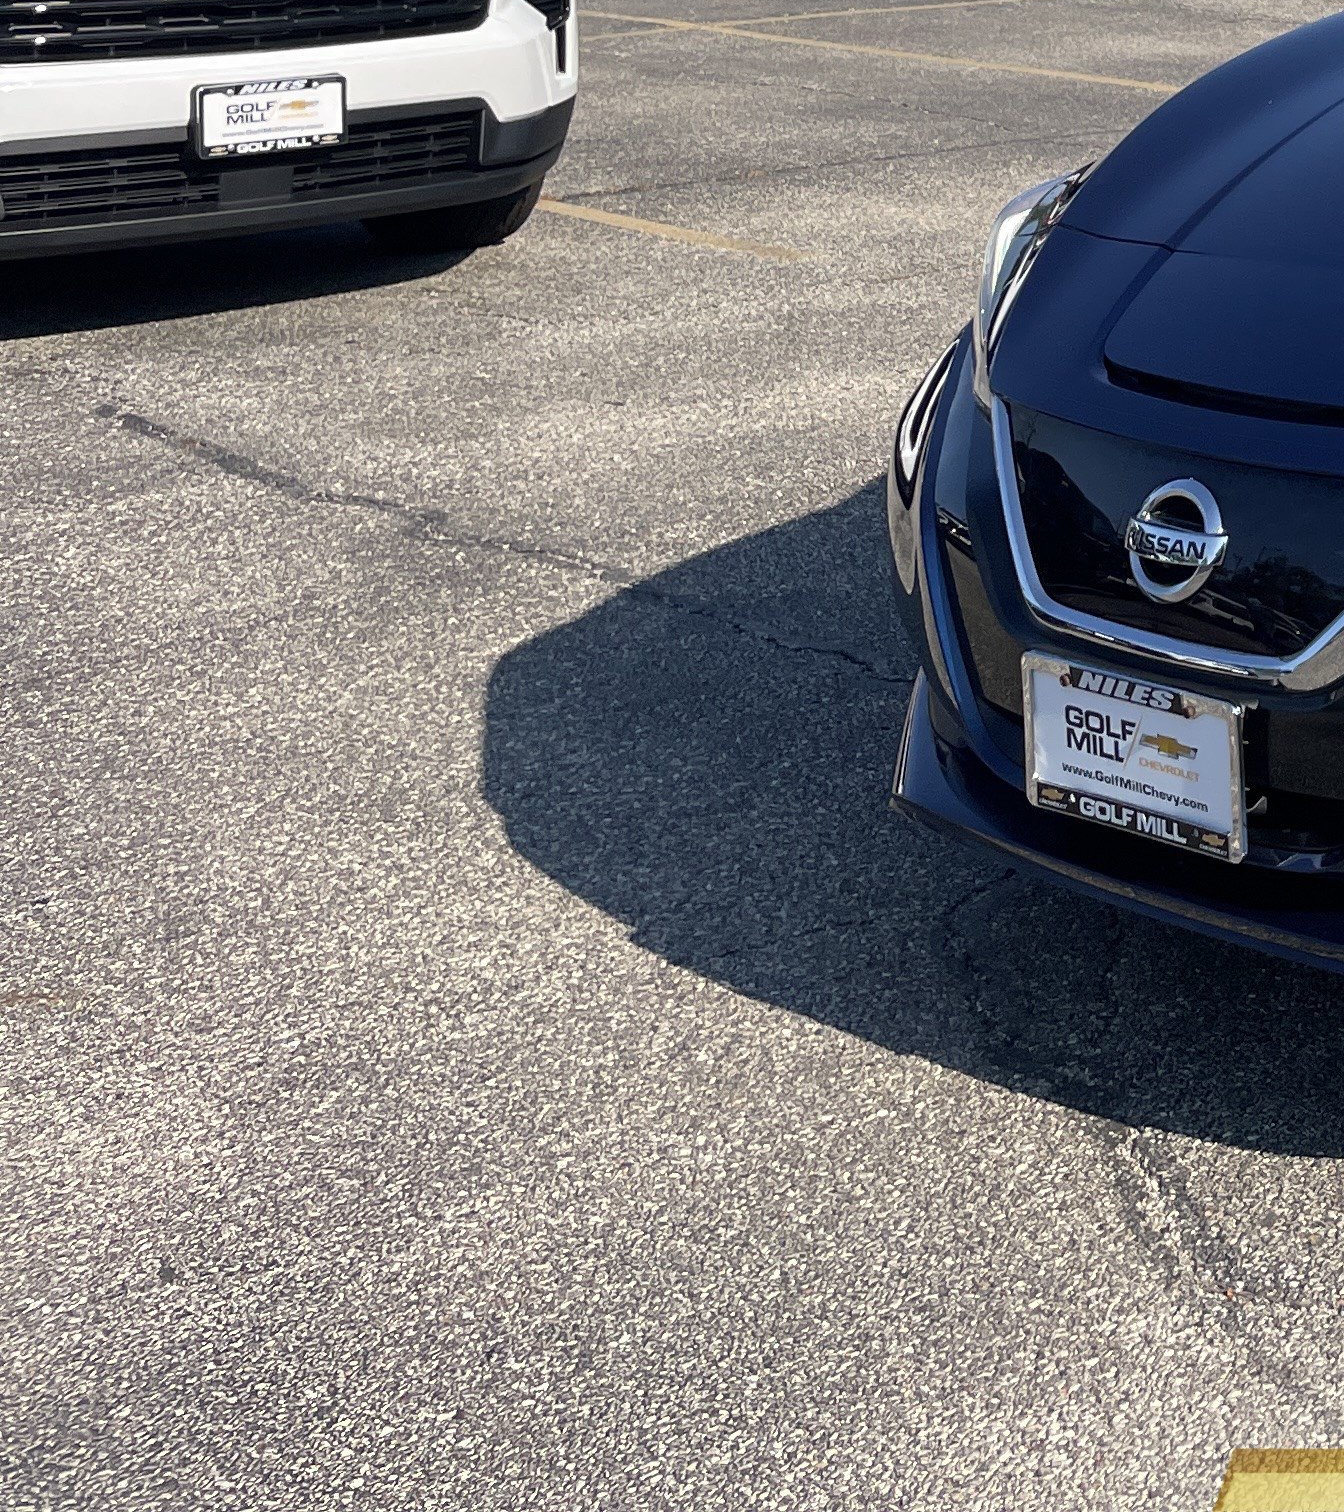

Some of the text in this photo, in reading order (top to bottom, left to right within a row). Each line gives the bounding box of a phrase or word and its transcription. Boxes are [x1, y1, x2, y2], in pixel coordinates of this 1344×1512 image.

[238, 79, 308, 96] NILES
[226, 99, 278, 115] GOLF
[226, 111, 271, 126] MILL
[236, 139, 275, 154] GOLF
[276, 136, 312, 150] MILL
[1077, 670, 1175, 710] NILES
[1064, 704, 1136, 742] GOLF
[1065, 727, 1125, 763] MILL
[1061, 762, 1209, 813] www.GolfMillChevy.com
[1079, 796, 1188, 844] GOLF MILL
